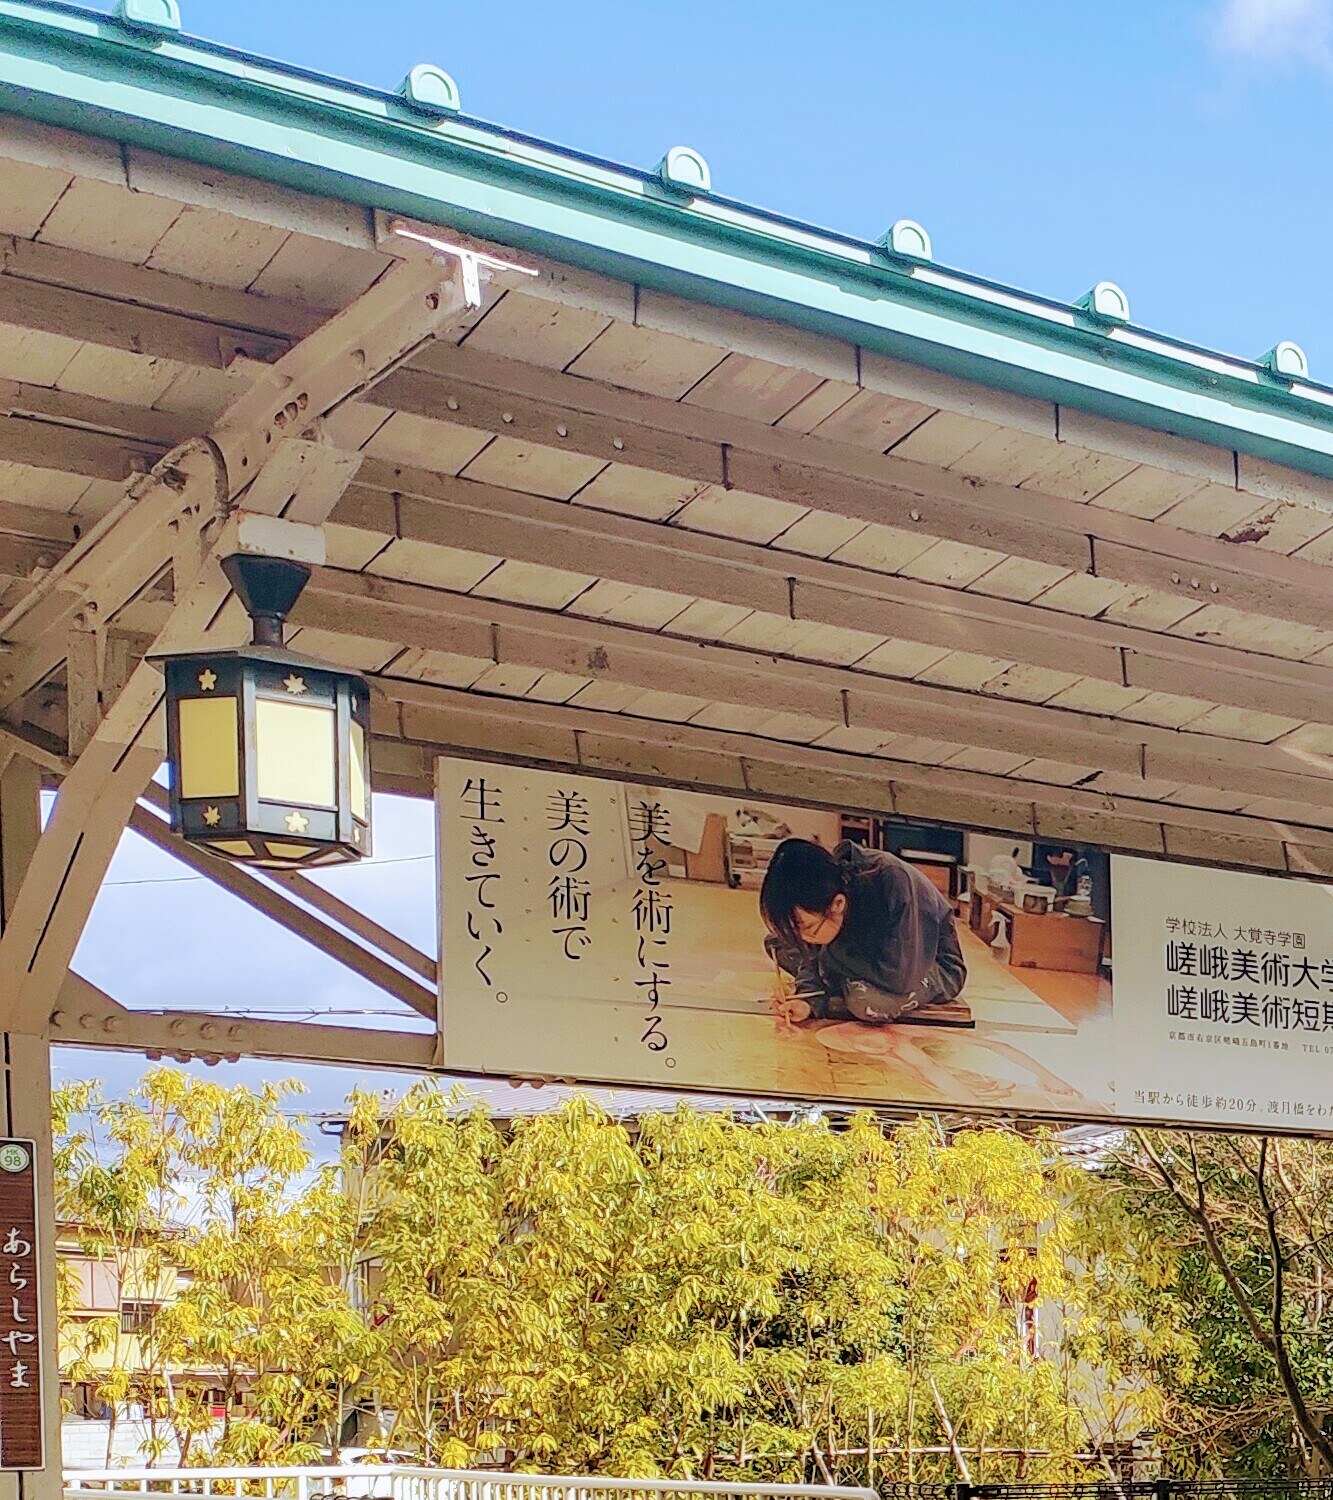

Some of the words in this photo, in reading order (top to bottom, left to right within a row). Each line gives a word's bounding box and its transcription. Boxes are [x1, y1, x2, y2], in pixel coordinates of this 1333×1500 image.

[460, 778, 508, 1003] 生きていく。
[546, 790, 592, 960] 美の術で
[629, 801, 677, 1068] 美を術にする。
[1165, 916, 1228, 940] 学校法人
[1233, 925, 1306, 949] 大覚寺学園
[1302, 1044, 1320, 1053] TEL
[4, 1155, 22, 1167] 98
[1, 1226, 35, 1388] あらしやま
